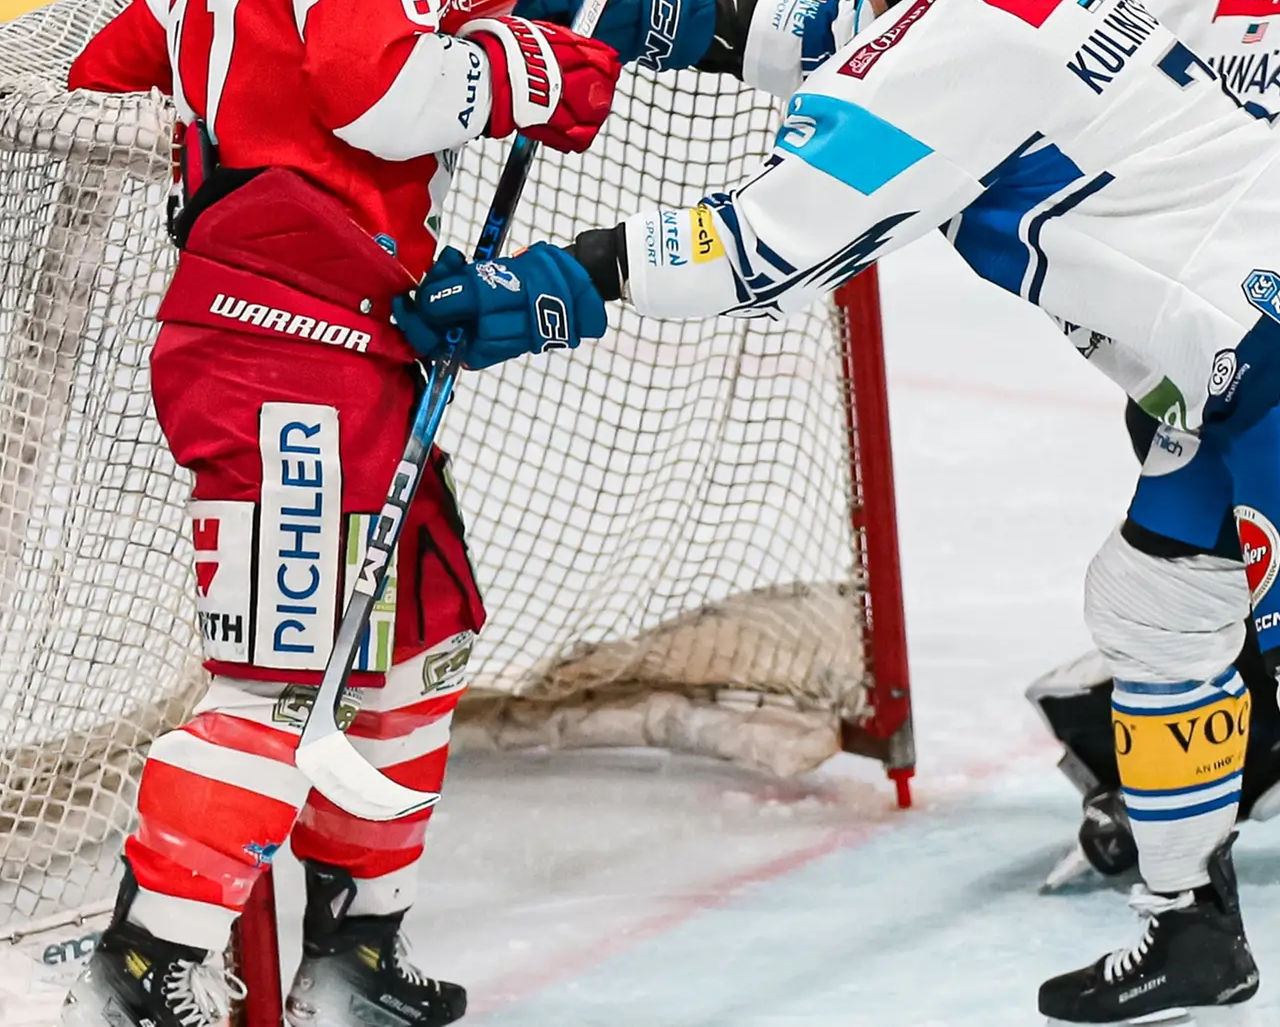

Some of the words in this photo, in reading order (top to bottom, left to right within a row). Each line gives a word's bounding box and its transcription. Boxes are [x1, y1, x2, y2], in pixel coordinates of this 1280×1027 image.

[458, 51, 481, 130] Auto
[209, 293, 372, 353] WARRIOR
[273, 421, 323, 654] PICHLER
[1164, 701, 1248, 753] VOC
